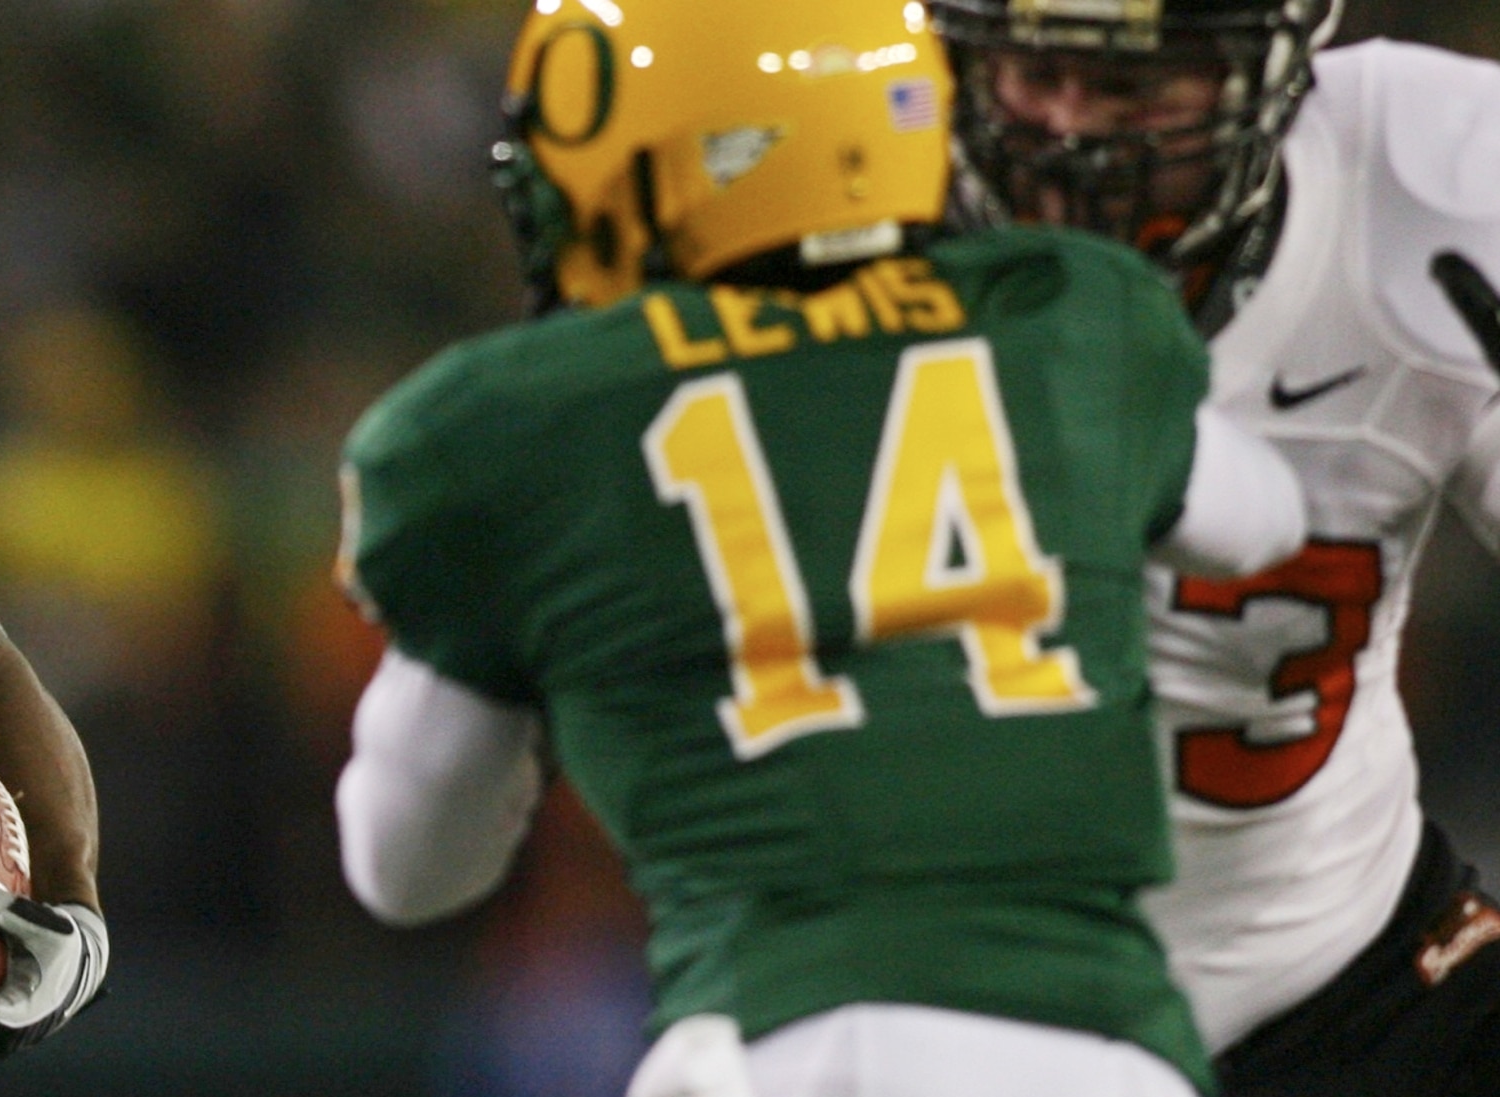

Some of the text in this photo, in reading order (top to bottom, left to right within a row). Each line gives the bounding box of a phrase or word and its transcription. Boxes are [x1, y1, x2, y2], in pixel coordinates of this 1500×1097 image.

[643, 256, 966, 371] LEWIS
[641, 336, 1099, 761] 14
[1171, 536, 1384, 811] 3
